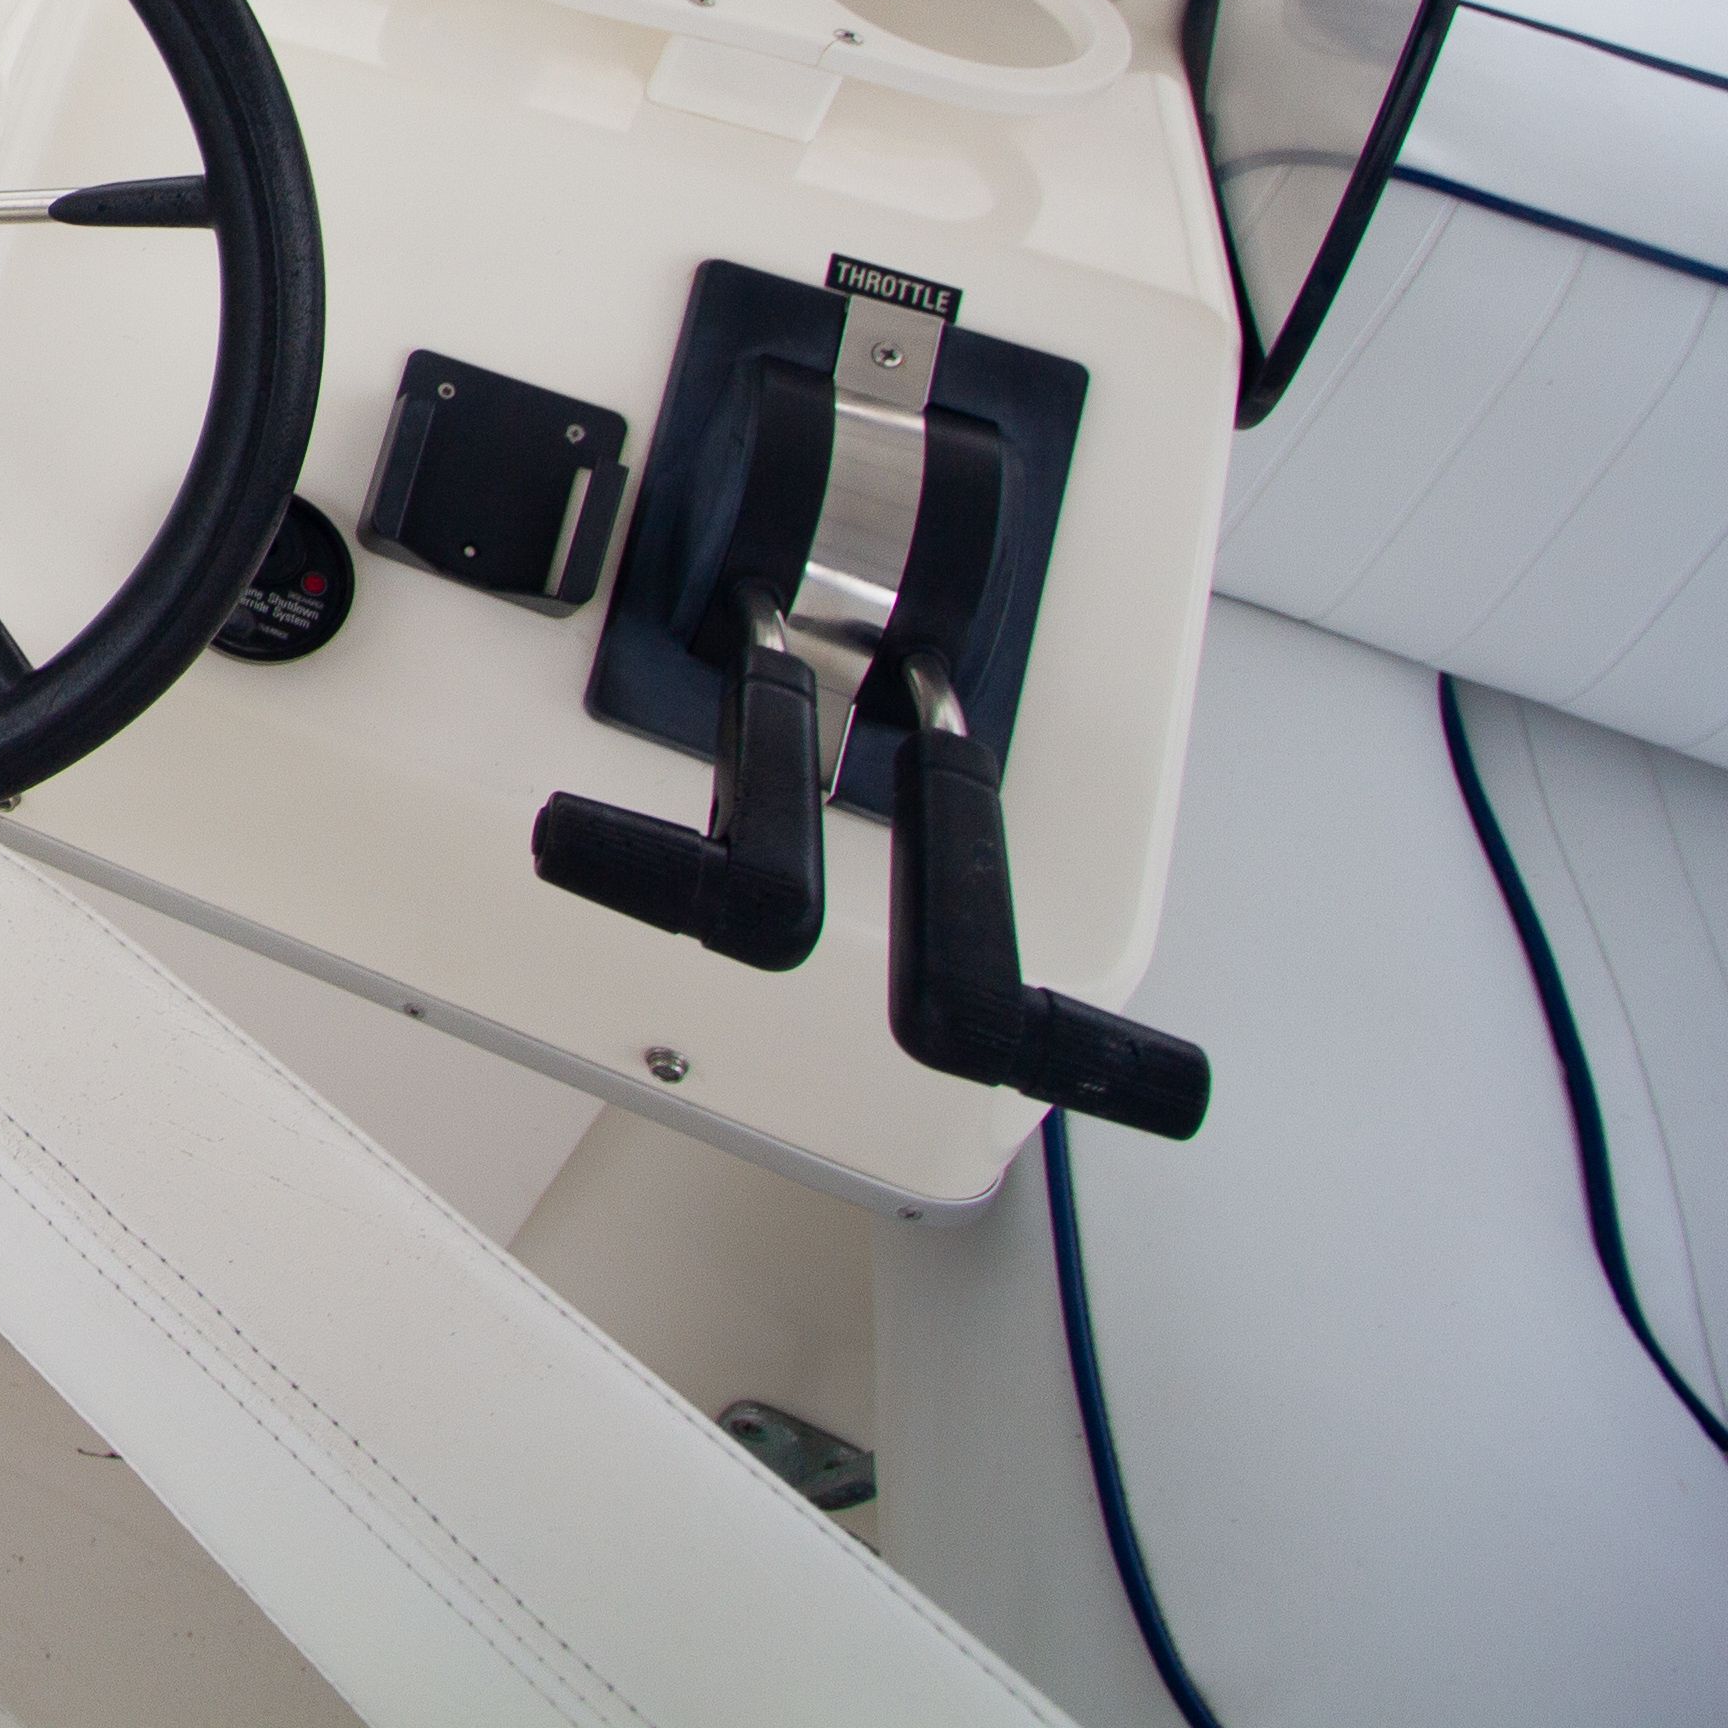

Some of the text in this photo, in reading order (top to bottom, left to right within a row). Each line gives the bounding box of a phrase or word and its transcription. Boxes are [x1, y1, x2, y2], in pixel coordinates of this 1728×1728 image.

[836, 260, 952, 314] THROTTLE
[267, 591, 321, 622] Shutdown
[272, 607, 311, 630] System
